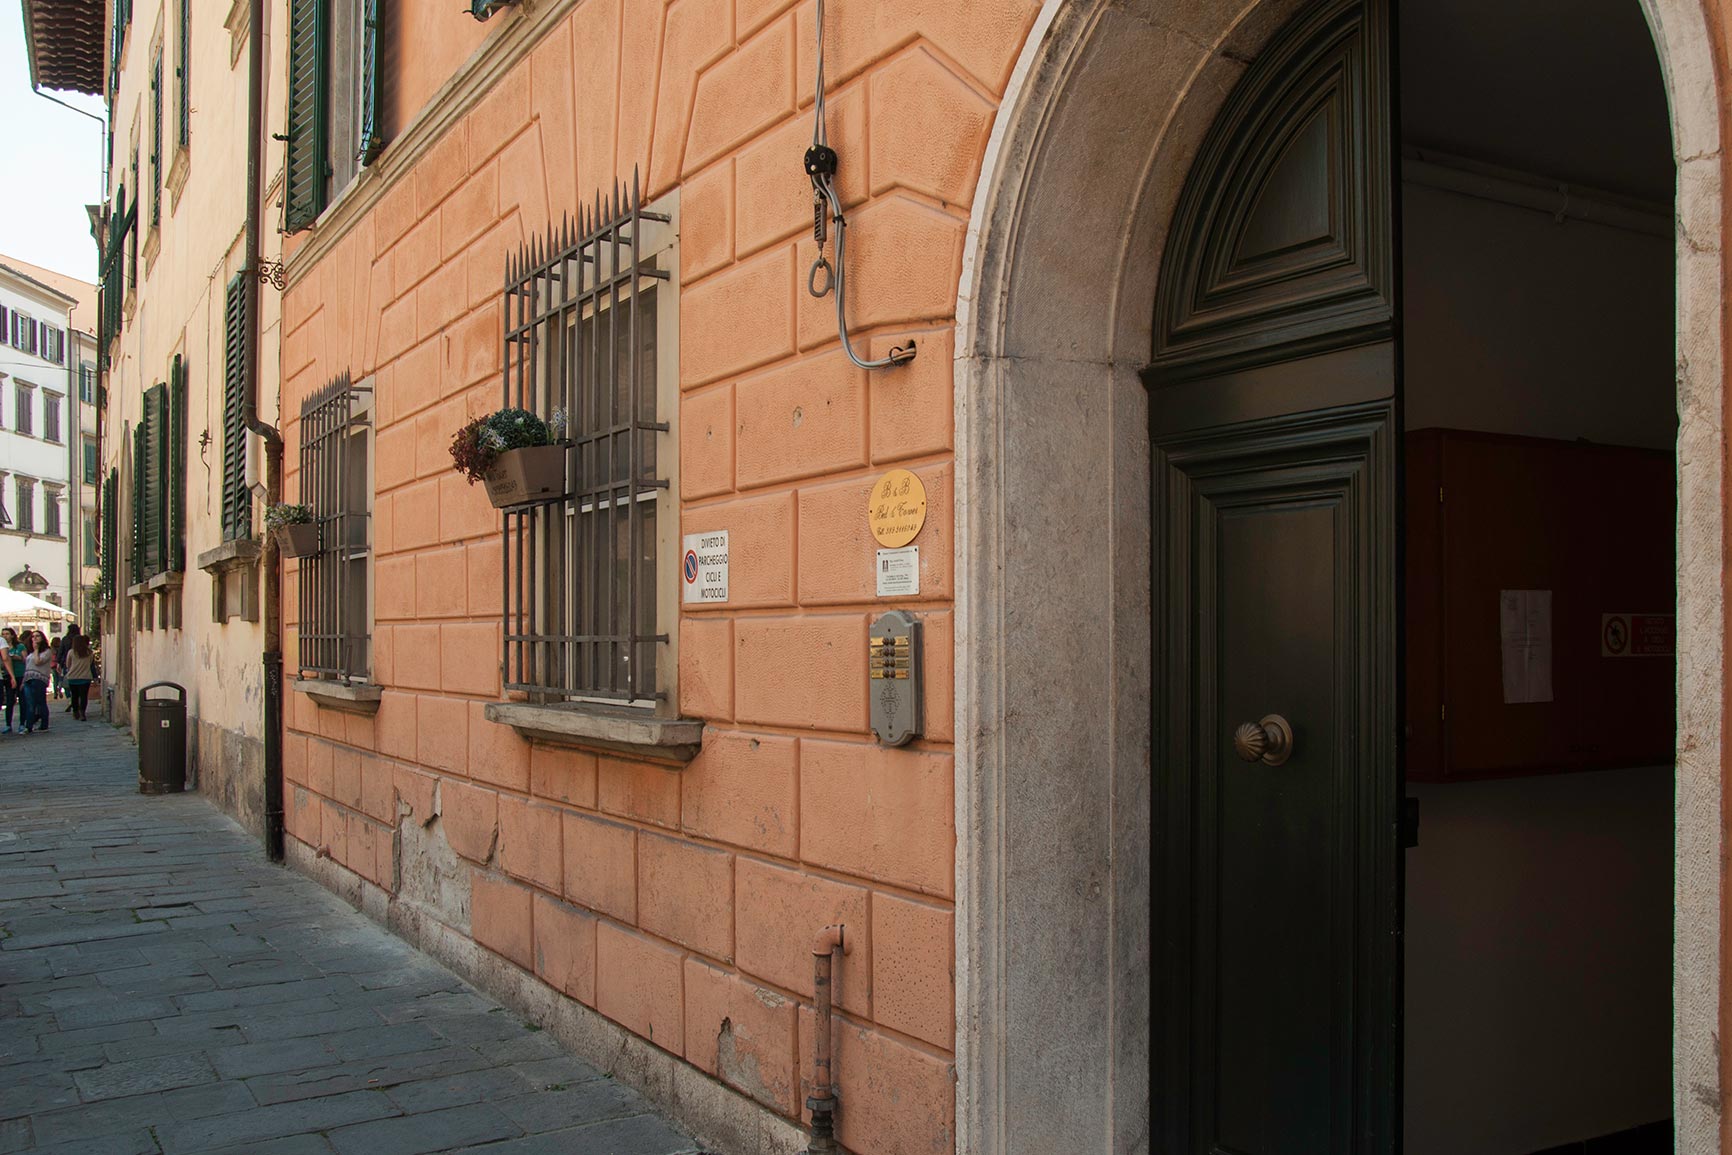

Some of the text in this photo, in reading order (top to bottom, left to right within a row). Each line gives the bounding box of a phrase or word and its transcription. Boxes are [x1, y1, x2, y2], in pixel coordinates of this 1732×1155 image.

[881, 480, 892, 499] B
[899, 476, 911, 496] B
[701, 536, 725, 549] DIVIETO DI
[699, 553, 728, 566] PARCHEGGIO
[706, 571, 717, 582] CICLI
[701, 587, 726, 598] MOTOCICLI
